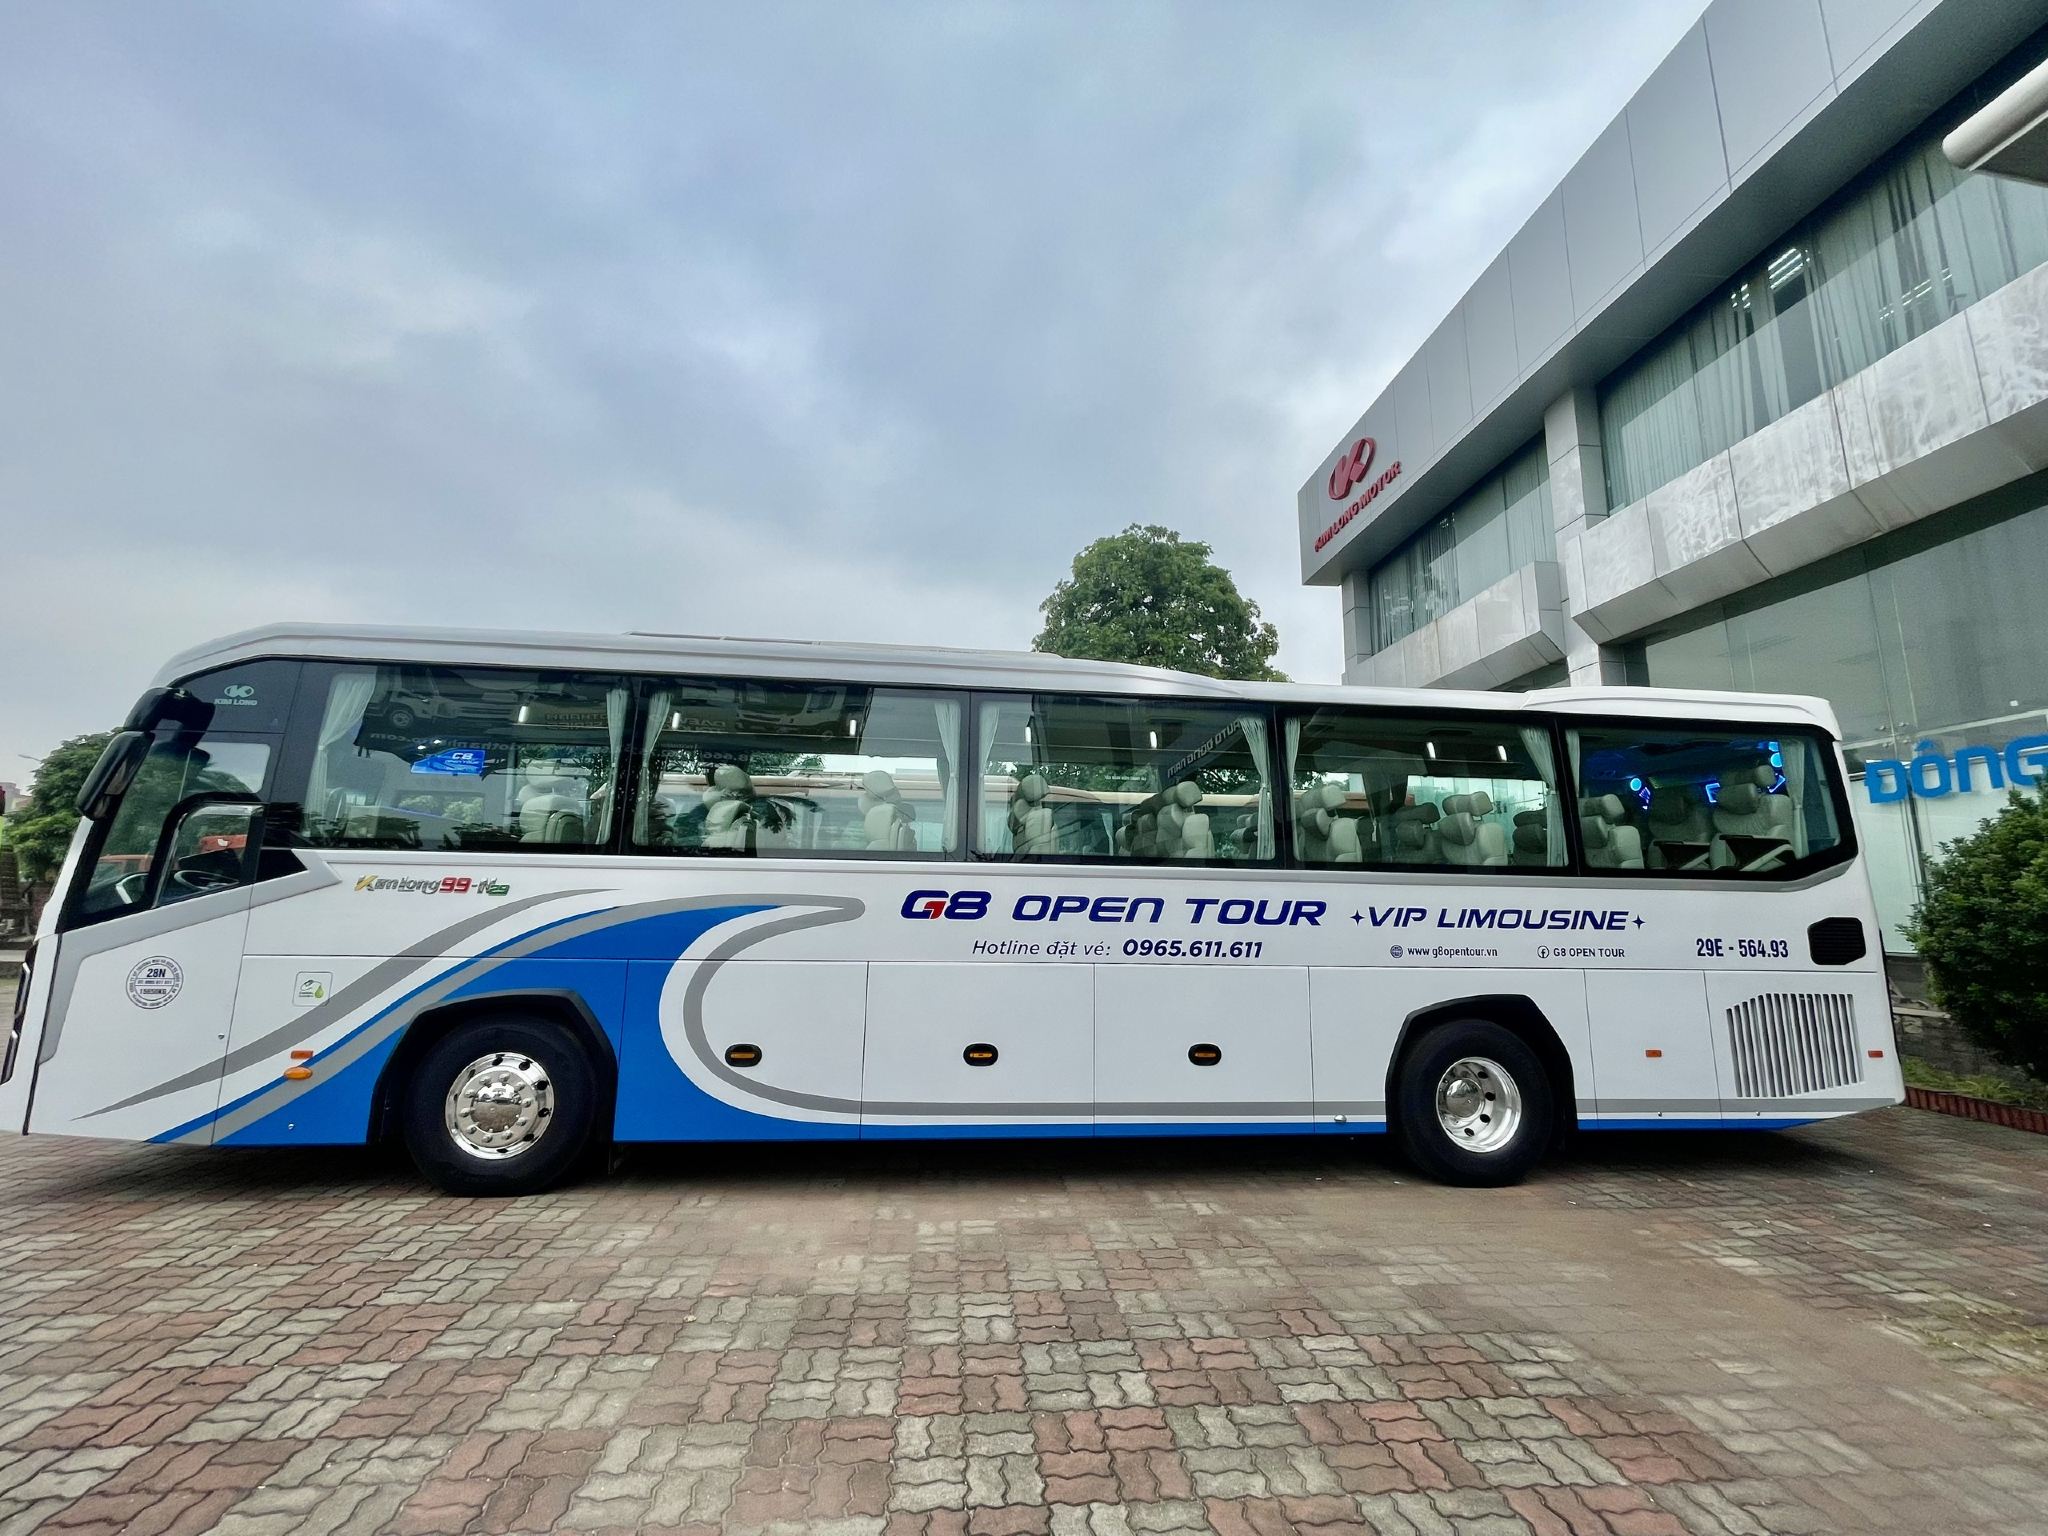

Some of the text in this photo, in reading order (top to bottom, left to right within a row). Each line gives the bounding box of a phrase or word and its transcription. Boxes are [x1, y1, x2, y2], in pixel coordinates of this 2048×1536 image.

[1334, 501, 1359, 535] LONG
[1358, 460, 1402, 510] MOTOR
[900, 889, 1328, 926] G8 OPEN TOUR
[1368, 906, 1630, 931] VIP LIMOUSINE
[972, 939, 1263, 959] Hotline đặt vé: 0965.611.611
[1553, 947, 1625, 957] G8 OPEN TOUR
[1696, 938, 1724, 957] 29E
[1738, 939, 1789, 958] 564.93
[146, 968, 167, 978] 28N
